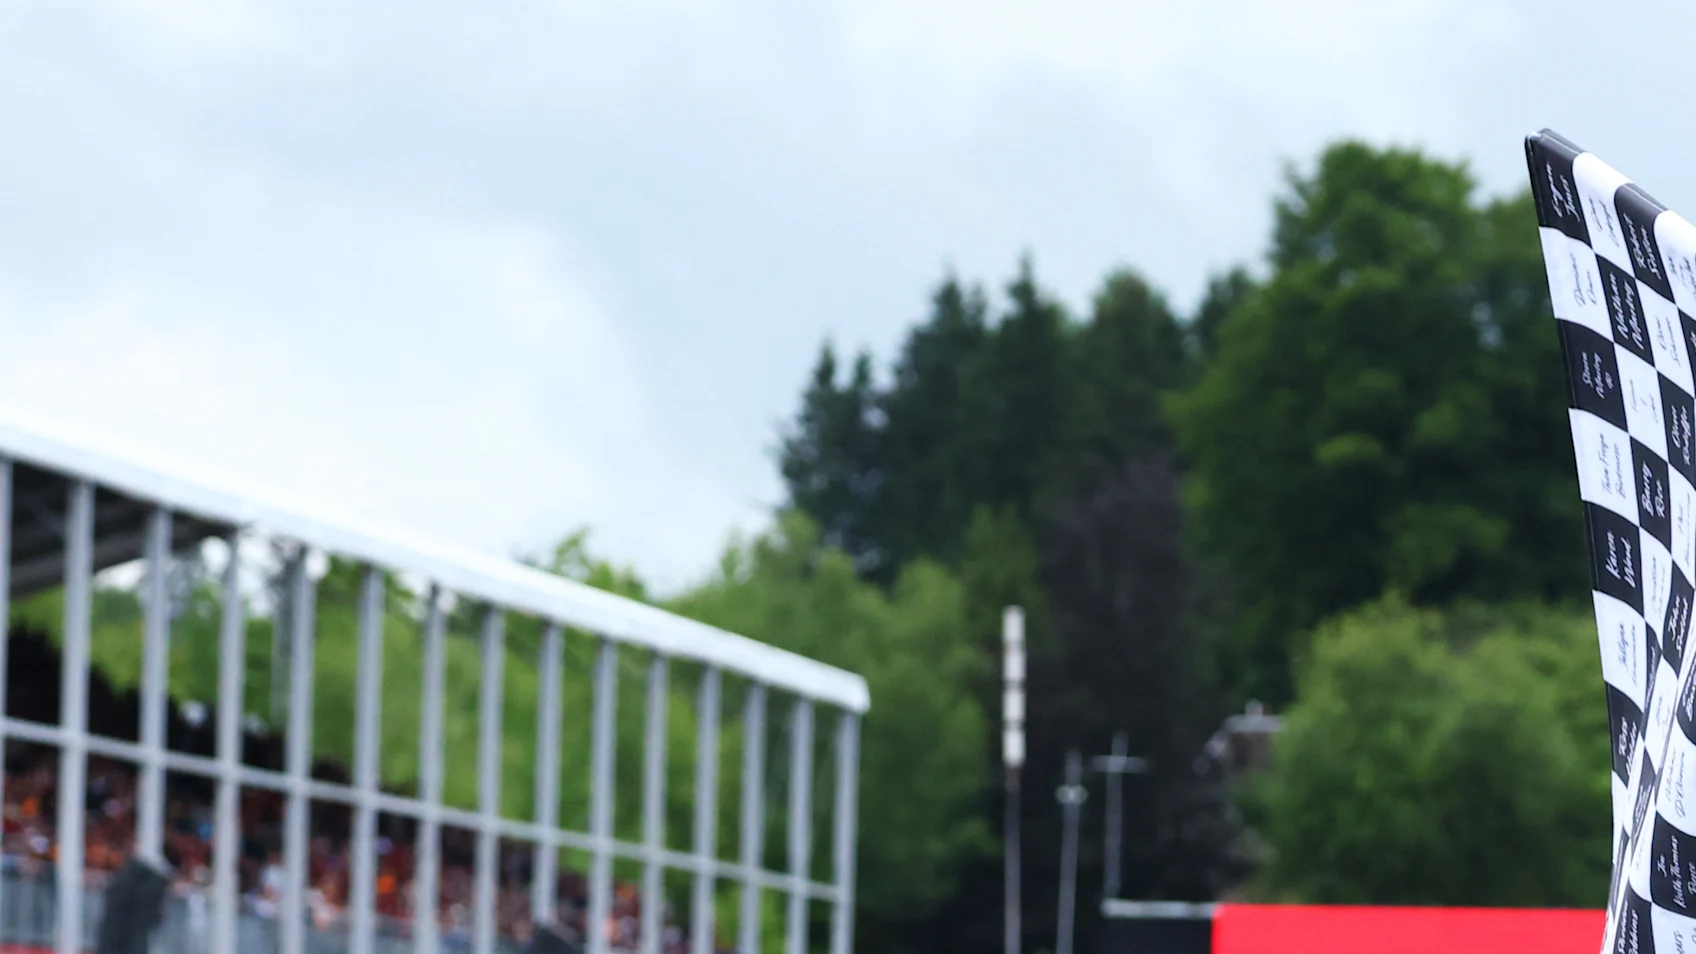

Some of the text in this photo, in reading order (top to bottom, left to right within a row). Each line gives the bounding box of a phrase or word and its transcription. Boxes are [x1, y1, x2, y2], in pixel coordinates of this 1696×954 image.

[1623, 212, 1647, 269] Robert
[1609, 271, 1629, 339] Nathan
[1641, 461, 1654, 516] Barry
[1605, 531, 1621, 579] Karen
[1621, 537, 1636, 588] Wood
[1670, 835, 1682, 879] Thomas
